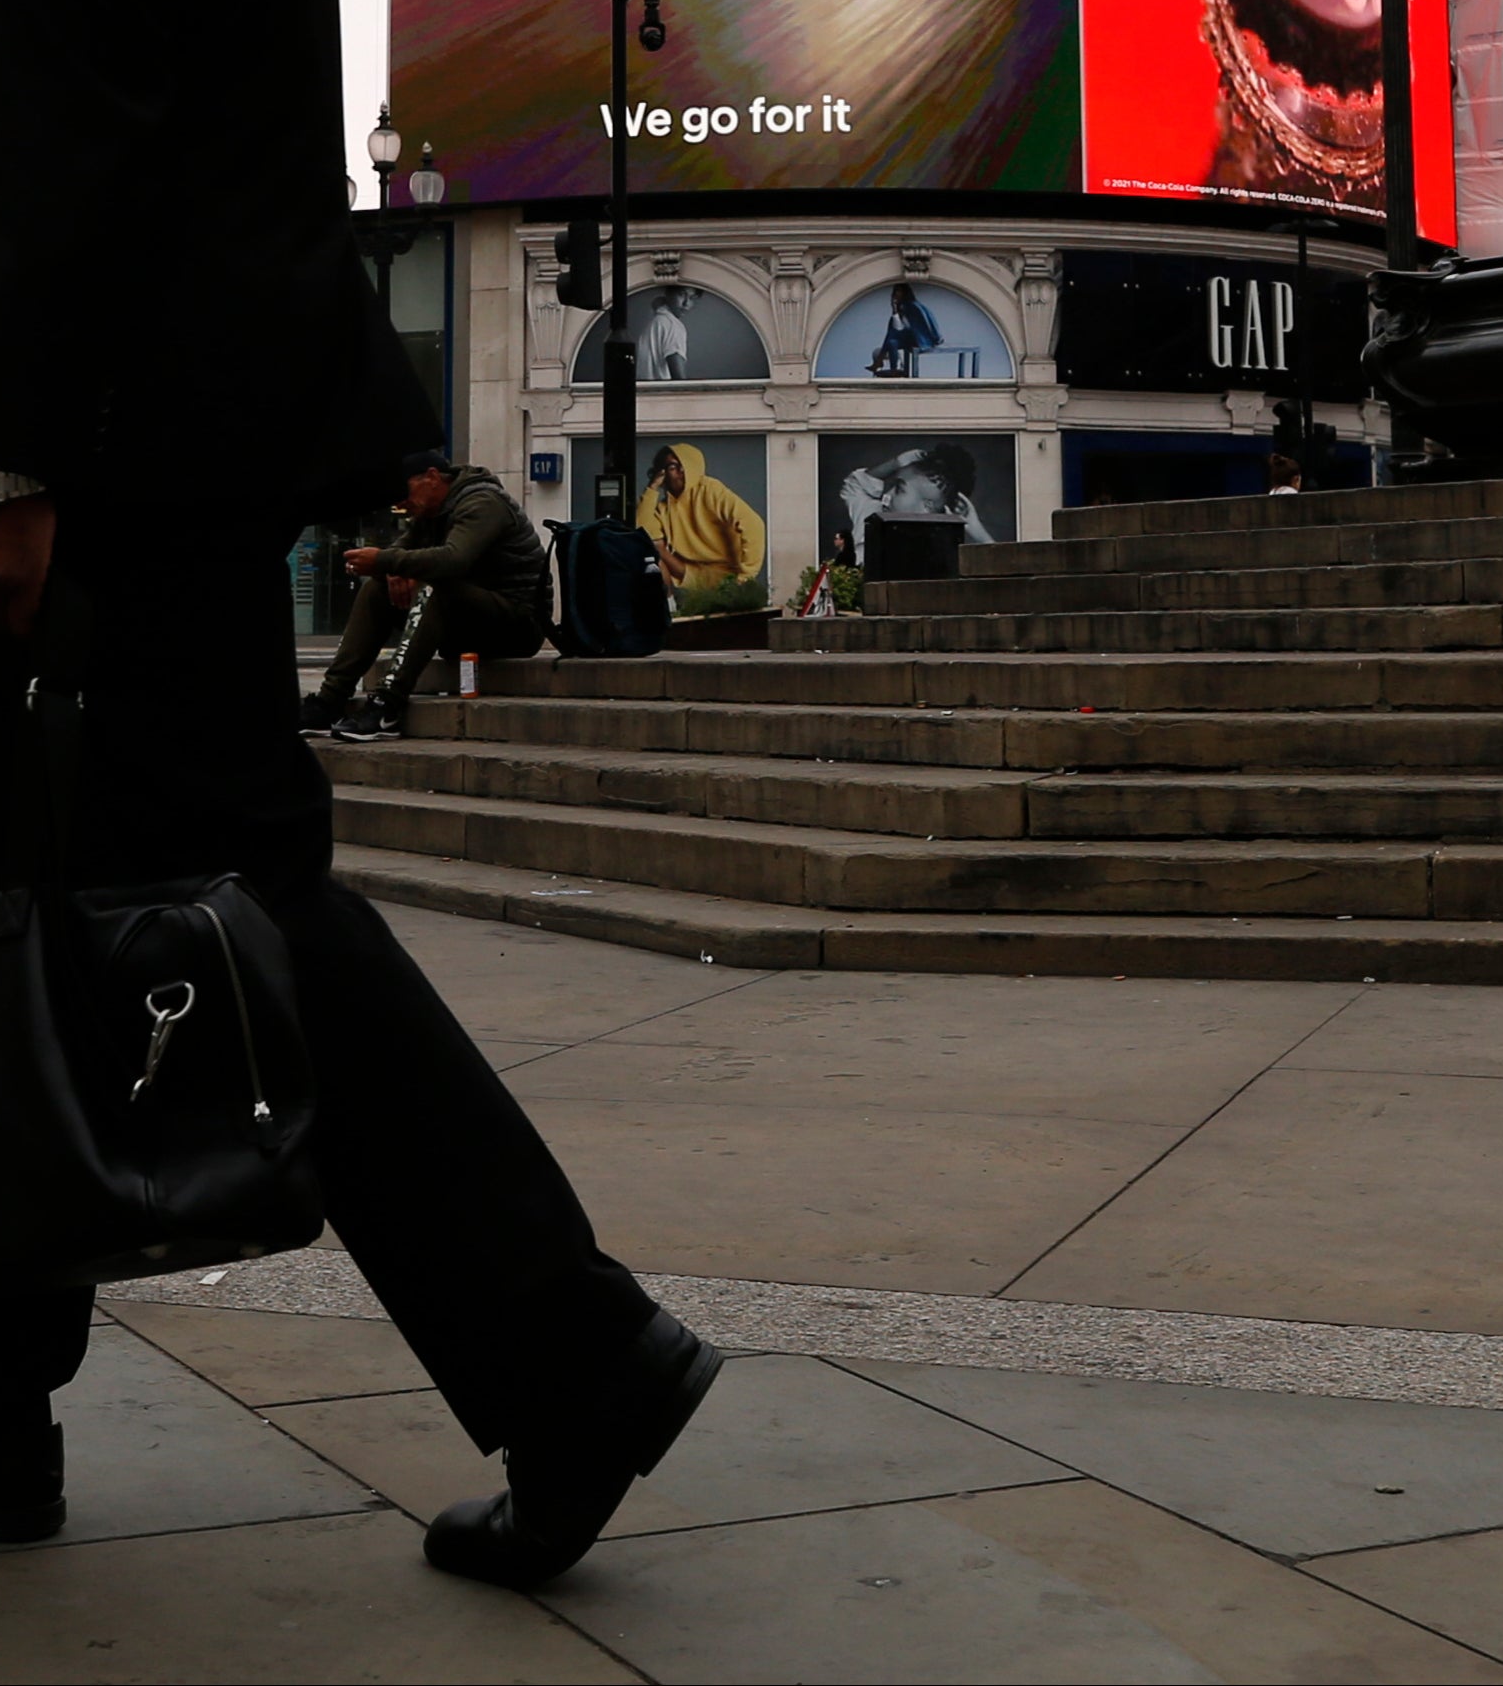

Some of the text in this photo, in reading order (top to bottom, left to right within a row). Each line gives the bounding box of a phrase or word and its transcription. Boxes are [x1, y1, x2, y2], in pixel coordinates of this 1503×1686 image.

[599, 94, 852, 144] We go for it
[1112, 179, 1131, 188] 2021
[1132, 180, 1146, 189] The
[1147, 181, 1184, 192] Coca-Cola
[1185, 183, 1218, 195] Company.
[1219, 186, 1229, 195] All
[1229, 187, 1248, 197] rights
[1249, 190, 1277, 201] reserved.
[1208, 276, 1294, 370] GAP
[534, 461, 551, 473] GAP
